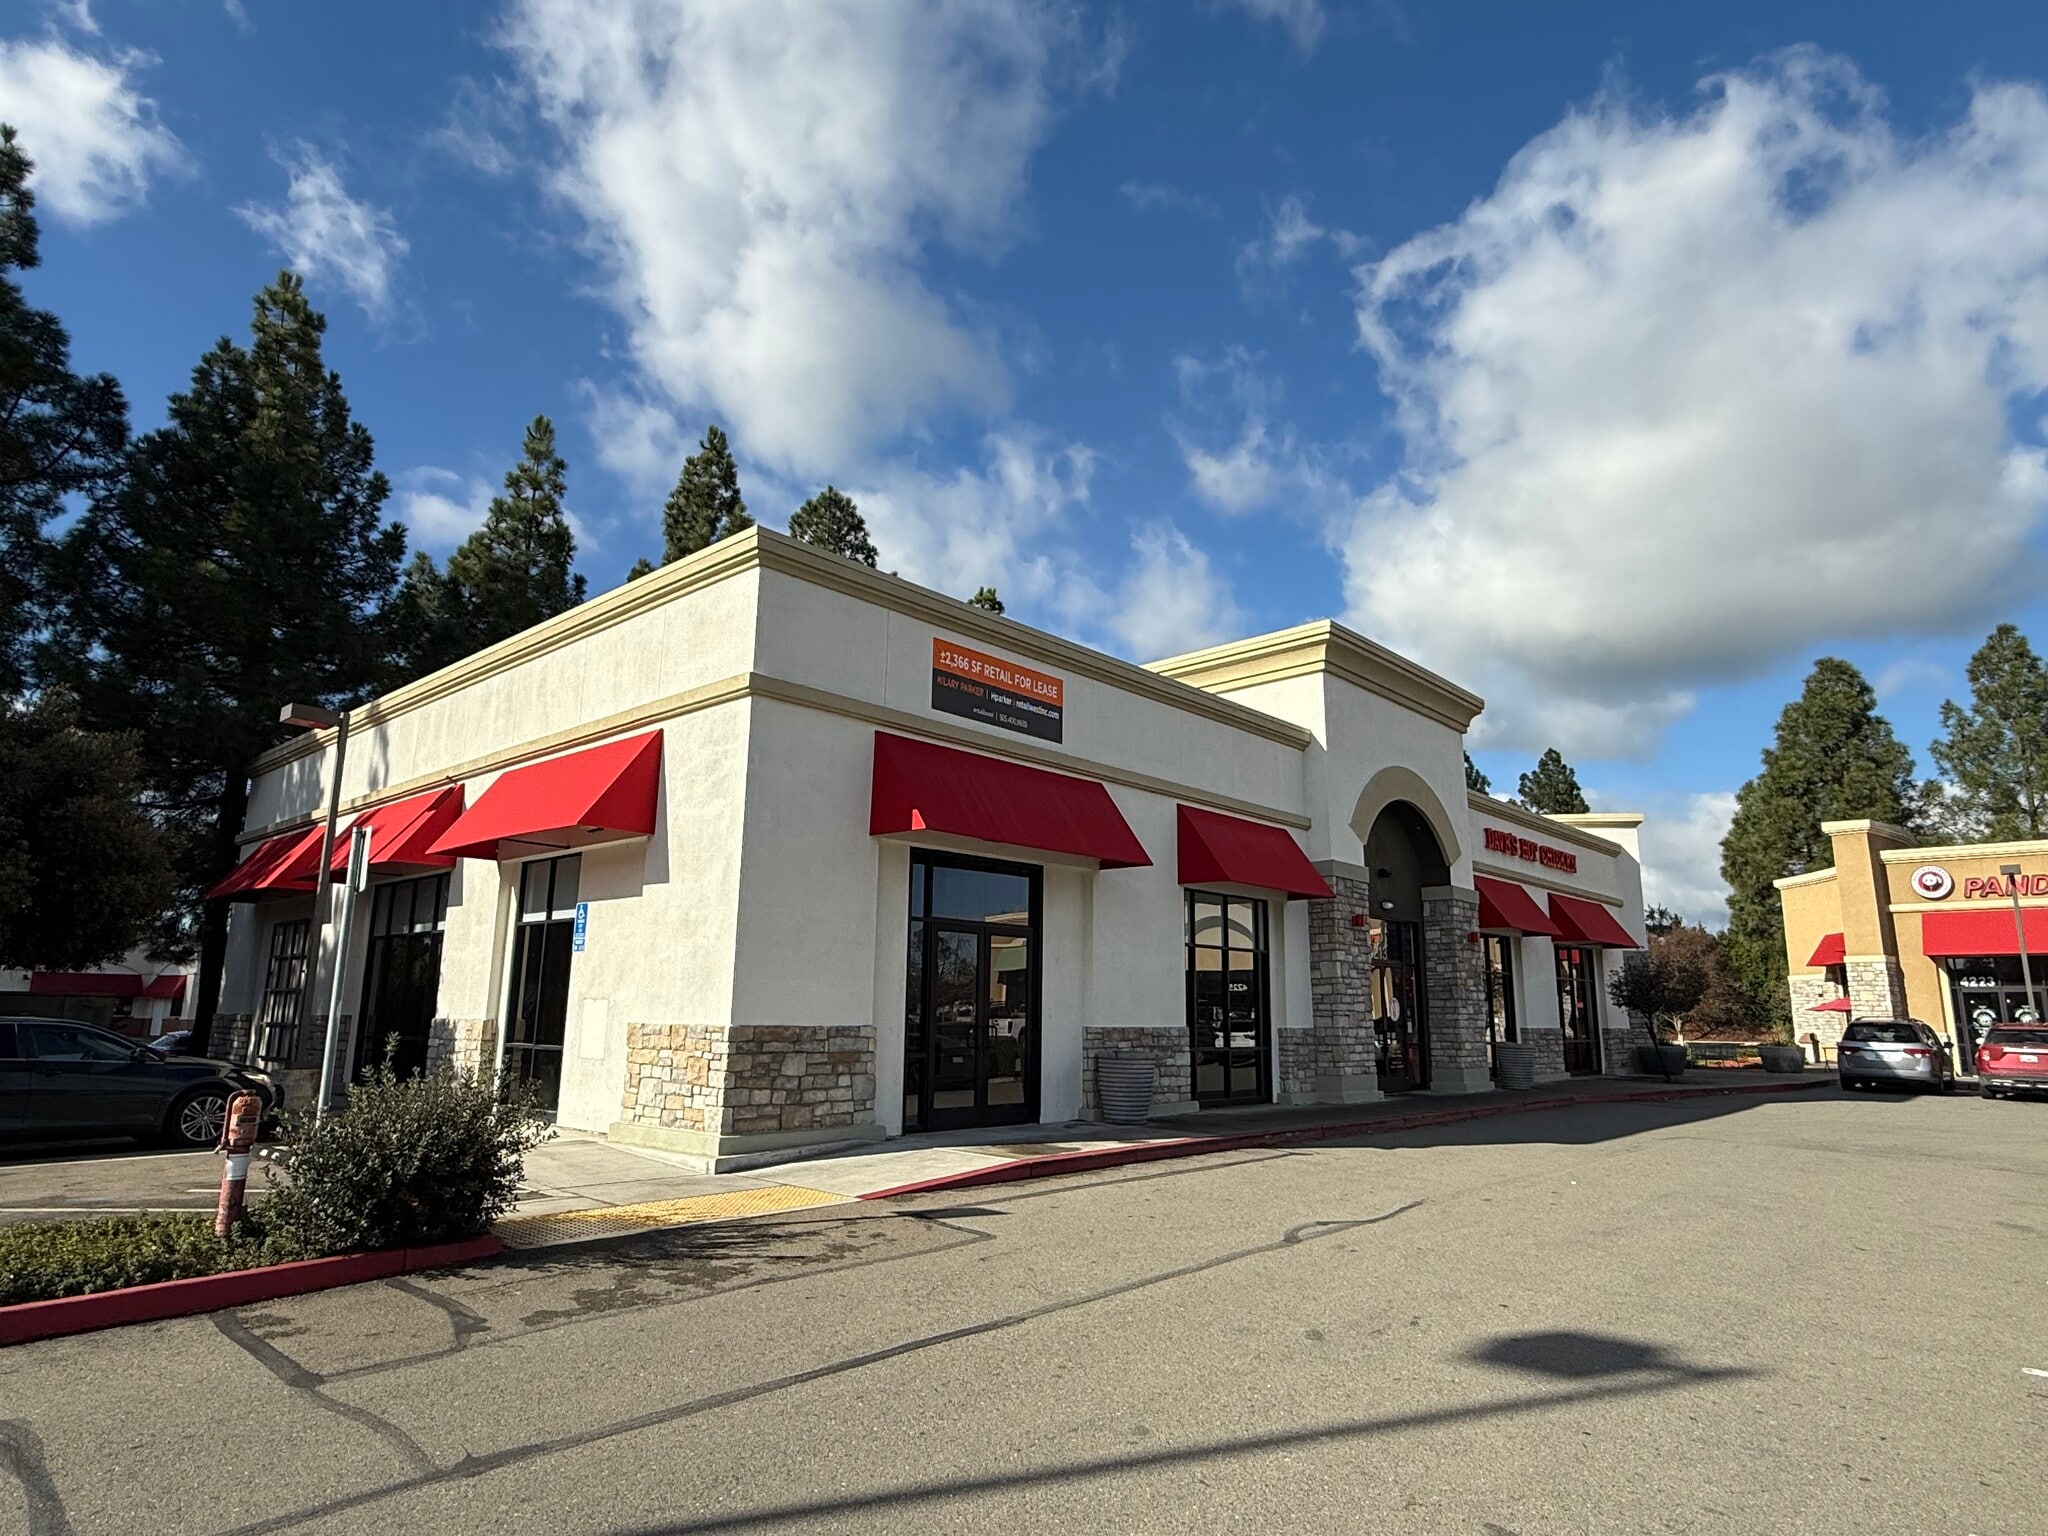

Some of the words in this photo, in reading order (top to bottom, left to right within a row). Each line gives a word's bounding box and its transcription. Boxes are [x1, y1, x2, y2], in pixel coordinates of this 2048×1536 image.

[971, 660, 982, 674] SF
[984, 665, 1013, 684] RETAIL
[1014, 674, 1031, 690] FOR
[1033, 680, 1058, 698] LEASE
[960, 682, 985, 698] PARKER
[1519, 838, 1538, 862] HOT
[1960, 976, 1996, 988] 4223
